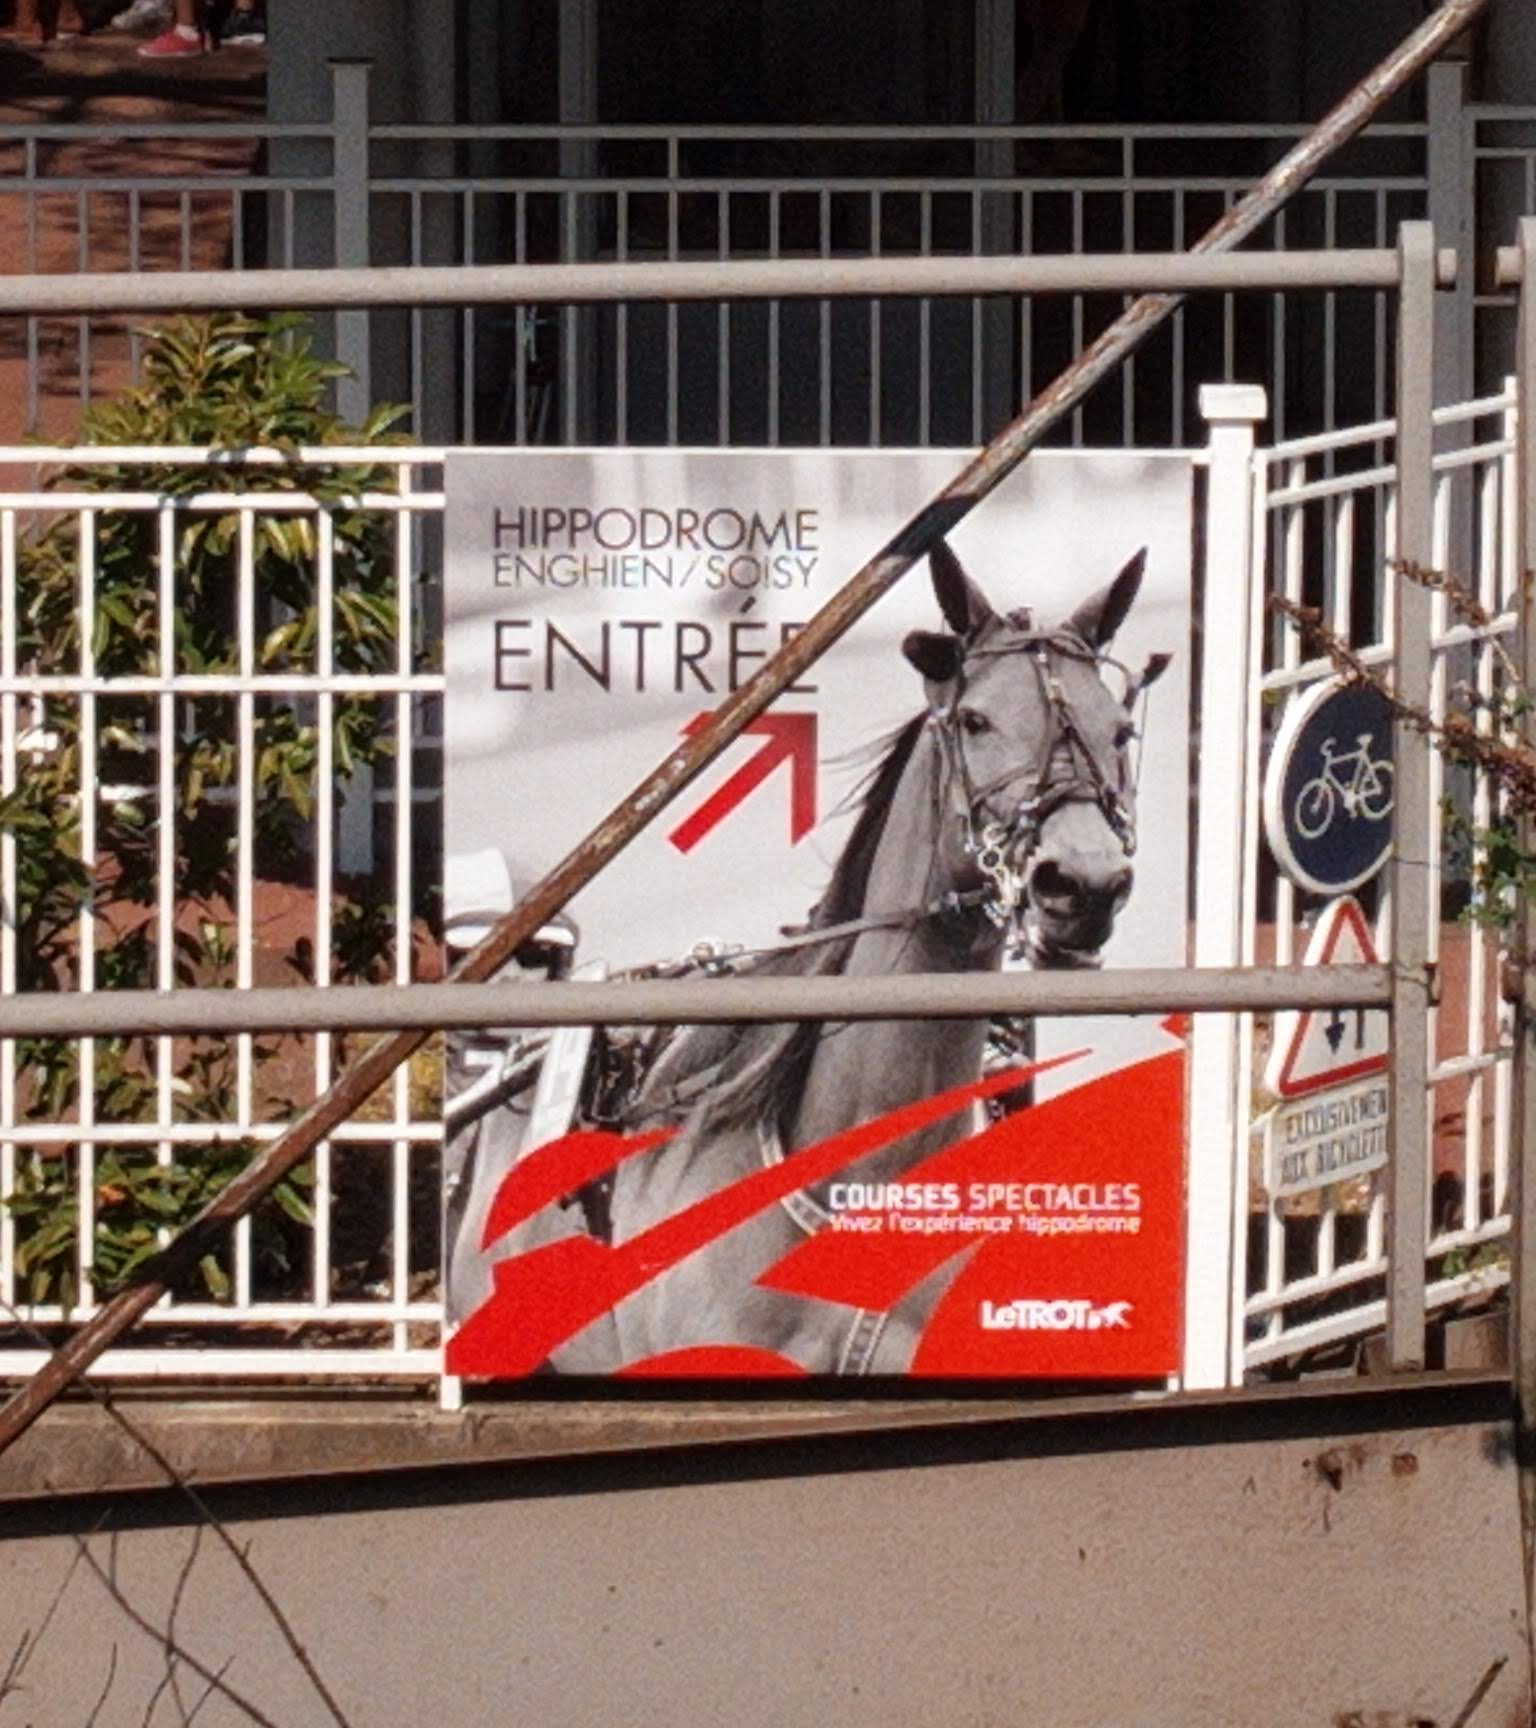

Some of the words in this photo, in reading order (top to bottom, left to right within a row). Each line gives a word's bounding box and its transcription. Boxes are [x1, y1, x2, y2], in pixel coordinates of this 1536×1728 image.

[494, 507, 819, 551] HIPPODROME
[829, 1183, 960, 1211] COURSES
[968, 1183, 1141, 1211] SPECTACLES
[829, 1213, 883, 1233] Vivez
[1018, 1213, 1142, 1236] hippodrome
[981, 1299, 1092, 1330] LeTROT
